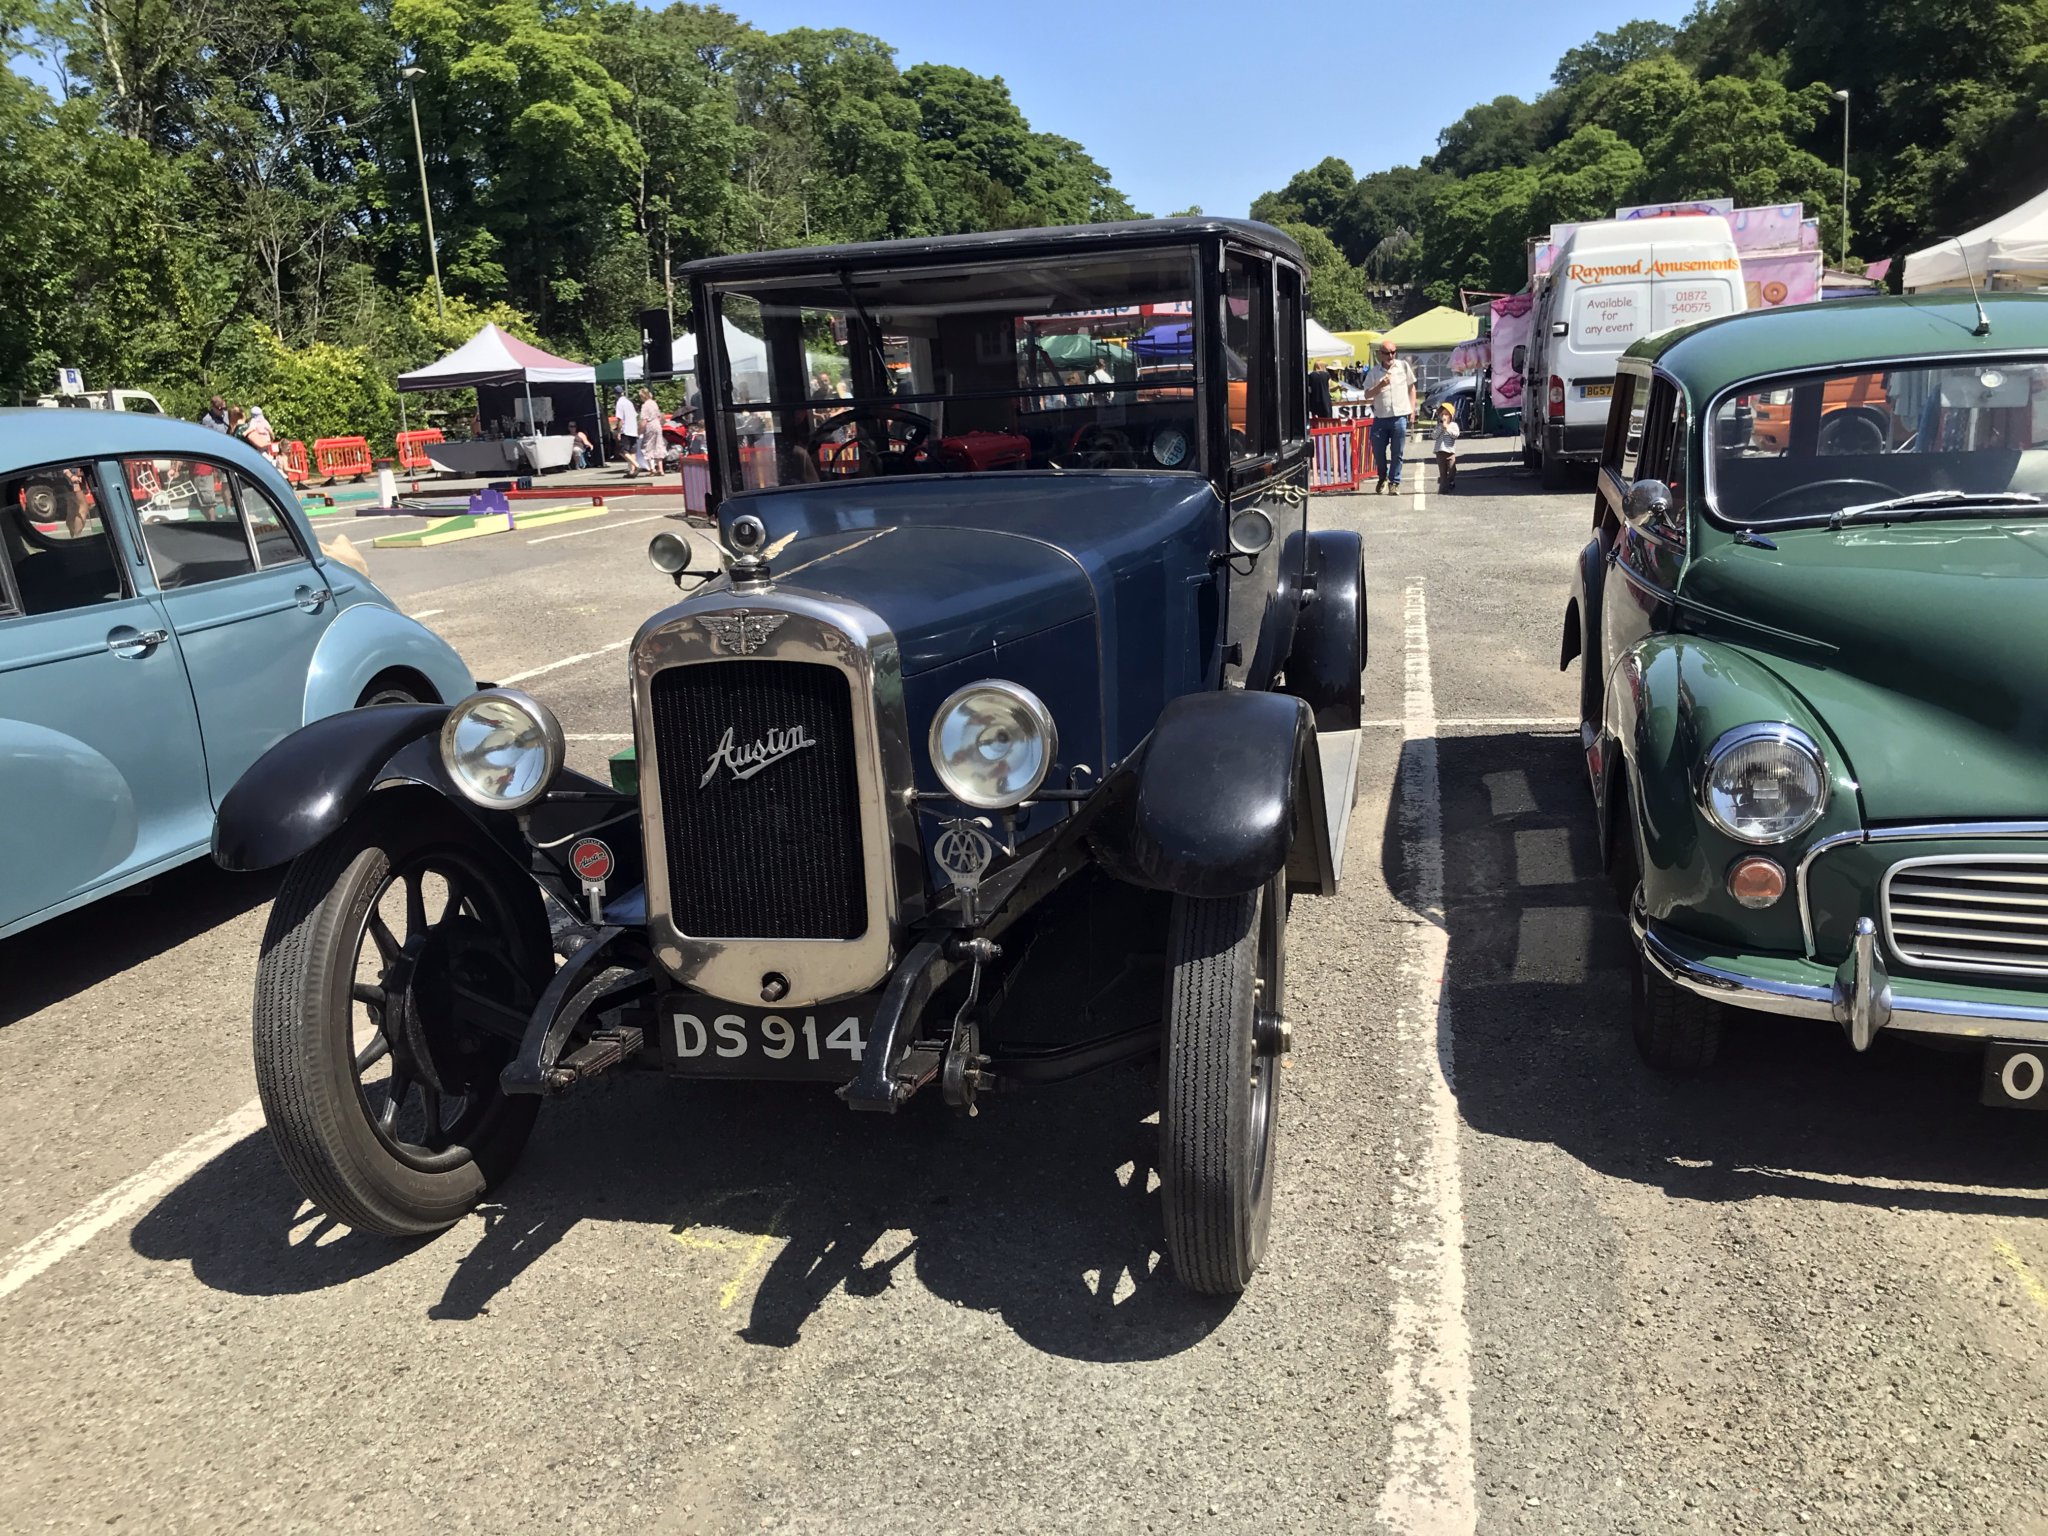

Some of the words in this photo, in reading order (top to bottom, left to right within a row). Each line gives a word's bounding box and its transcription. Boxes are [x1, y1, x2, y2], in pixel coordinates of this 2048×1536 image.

[1566, 259, 1642, 284] Raymond
[1645, 257, 1739, 277] Amusements
[1587, 296, 1633, 309] Available
[1676, 291, 1707, 302] 01872
[1671, 302, 1712, 314] 540575
[1602, 310, 1618, 321] for
[1585, 325, 1602, 336] any
[1605, 322, 1634, 333] event
[1587, 386, 1612, 396] BG57
[1338, 405, 1375, 419] SIL
[699, 725, 816, 790] Austin
[579, 851, 606, 868] Austin
[673, 1013, 748, 1059] DS
[761, 1014, 868, 1062] 914
